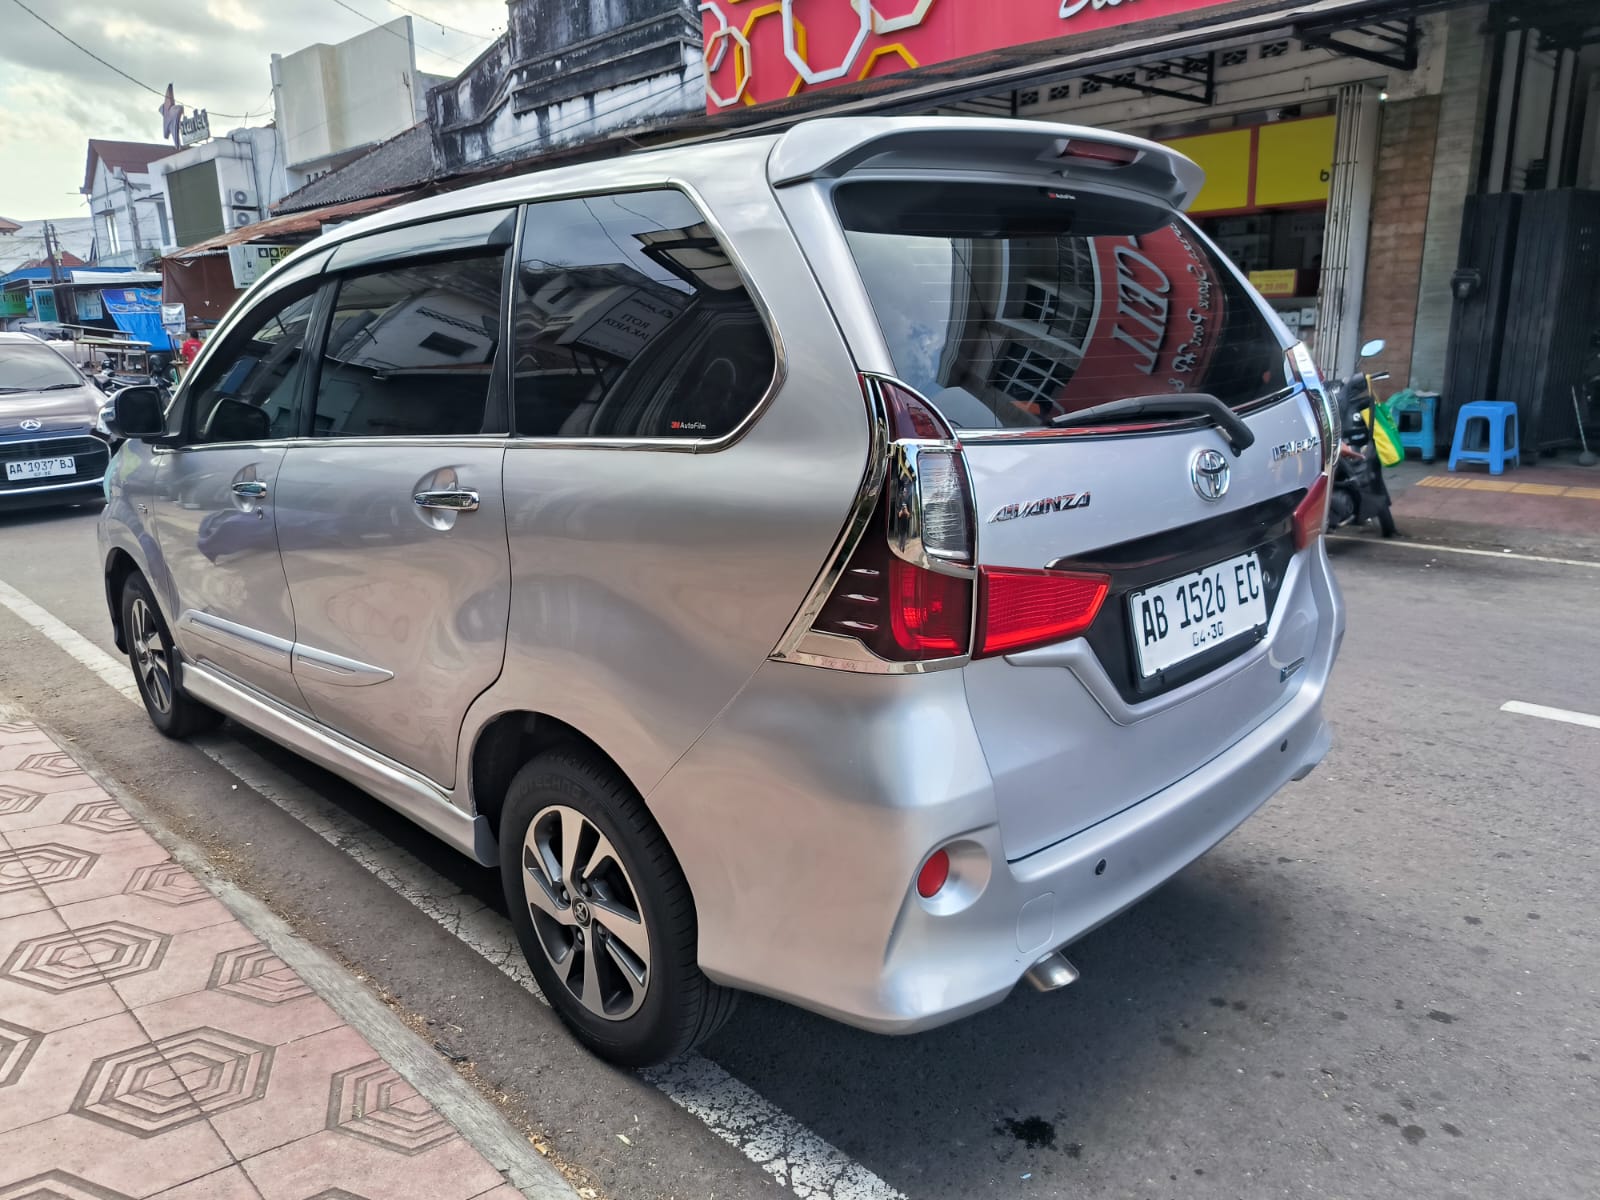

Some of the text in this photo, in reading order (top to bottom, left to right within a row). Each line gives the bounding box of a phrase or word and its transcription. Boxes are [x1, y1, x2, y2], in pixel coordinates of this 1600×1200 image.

[9, 463, 23, 475] AA
[27, 460, 54, 473] 1937
[59, 458, 74, 469] BJ
[987, 491, 1091, 524] AVANZA
[1143, 561, 1260, 647] AB 1526 EC
